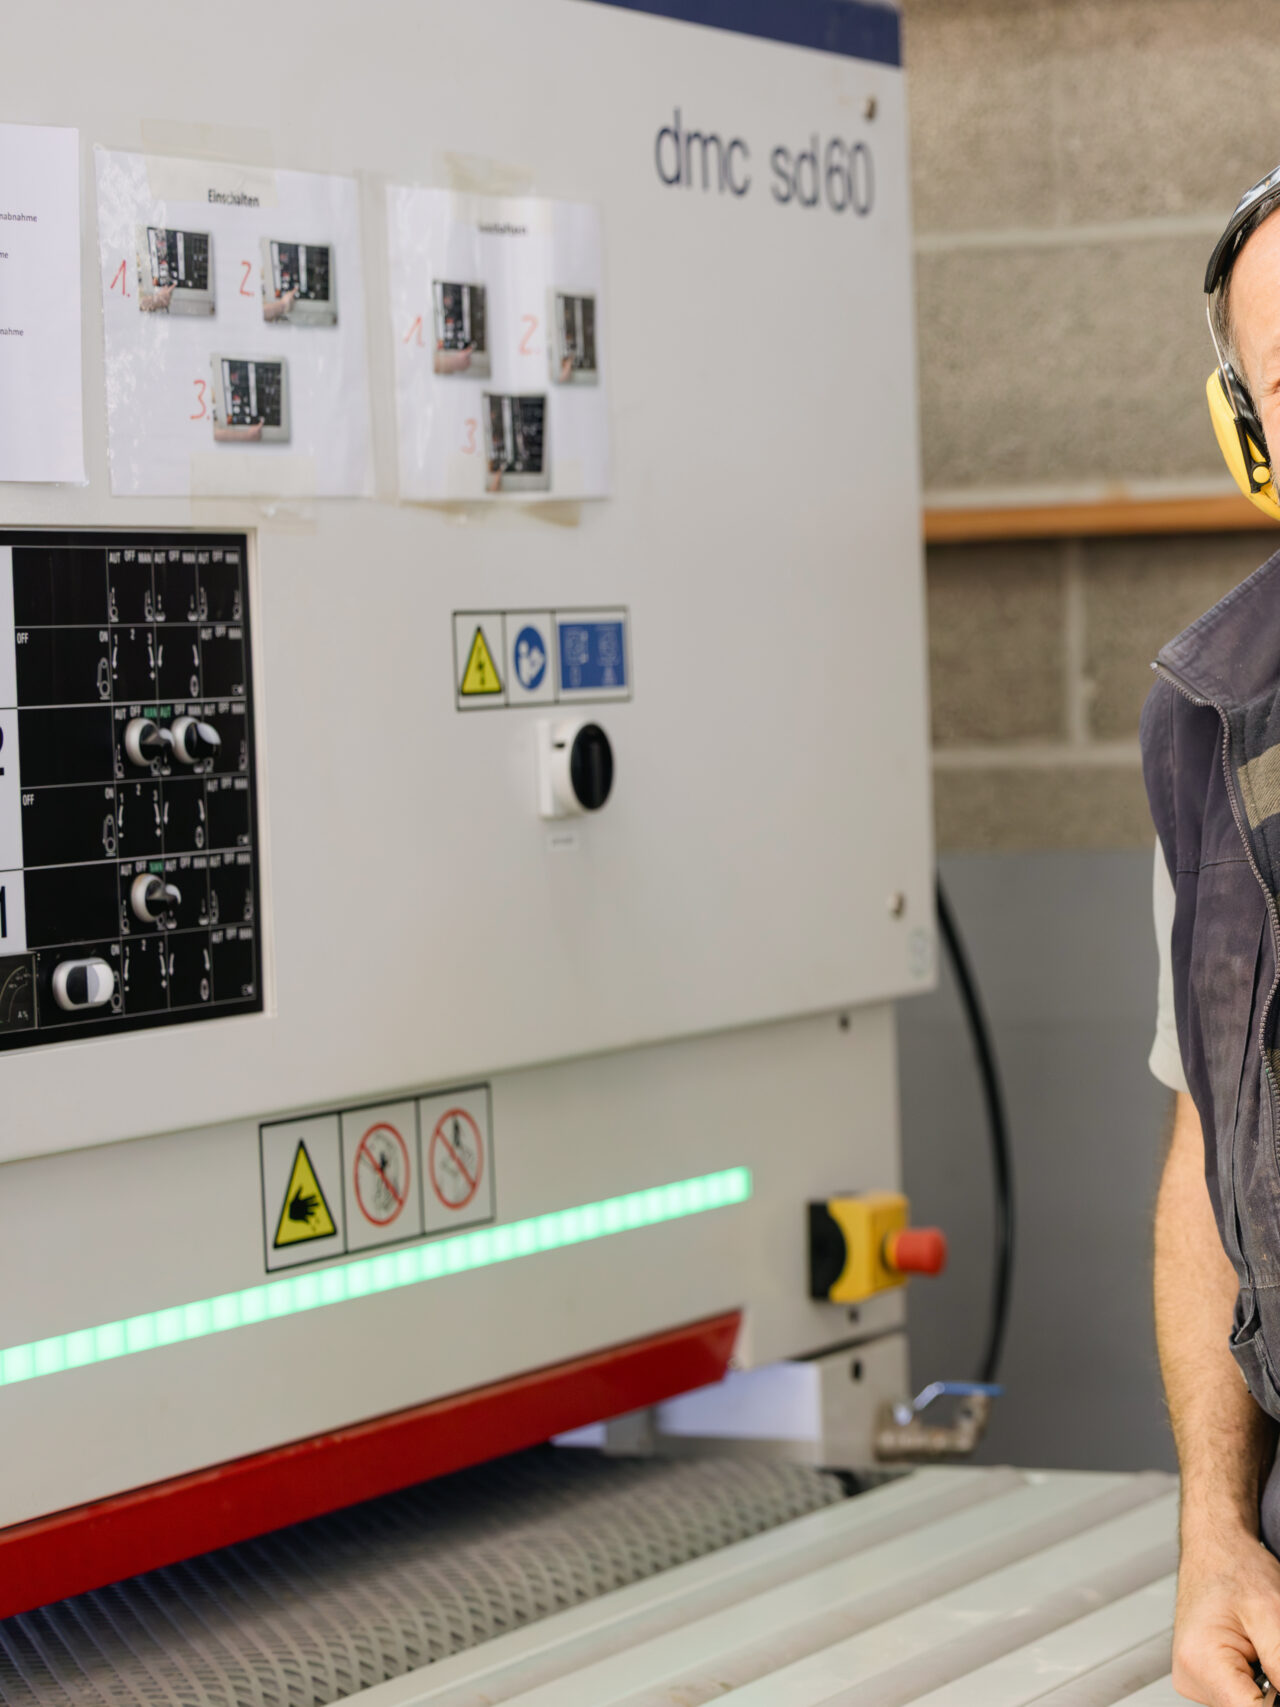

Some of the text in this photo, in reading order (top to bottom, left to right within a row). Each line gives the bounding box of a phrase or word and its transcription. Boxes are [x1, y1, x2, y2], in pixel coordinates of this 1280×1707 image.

[655, 105, 875, 217] dmc sd60
[208, 188, 260, 208] Einschalten
[189, 379, 211, 421] 3.
[124, 549, 136, 562] OFF
[168, 549, 180, 562] OFF
[16, 630, 109, 645] OFF ON
[130, 704, 142, 718] OFF
[22, 787, 115, 806] OFF ON
[135, 860, 147, 873] OFF
[180, 855, 191, 869] OFF
